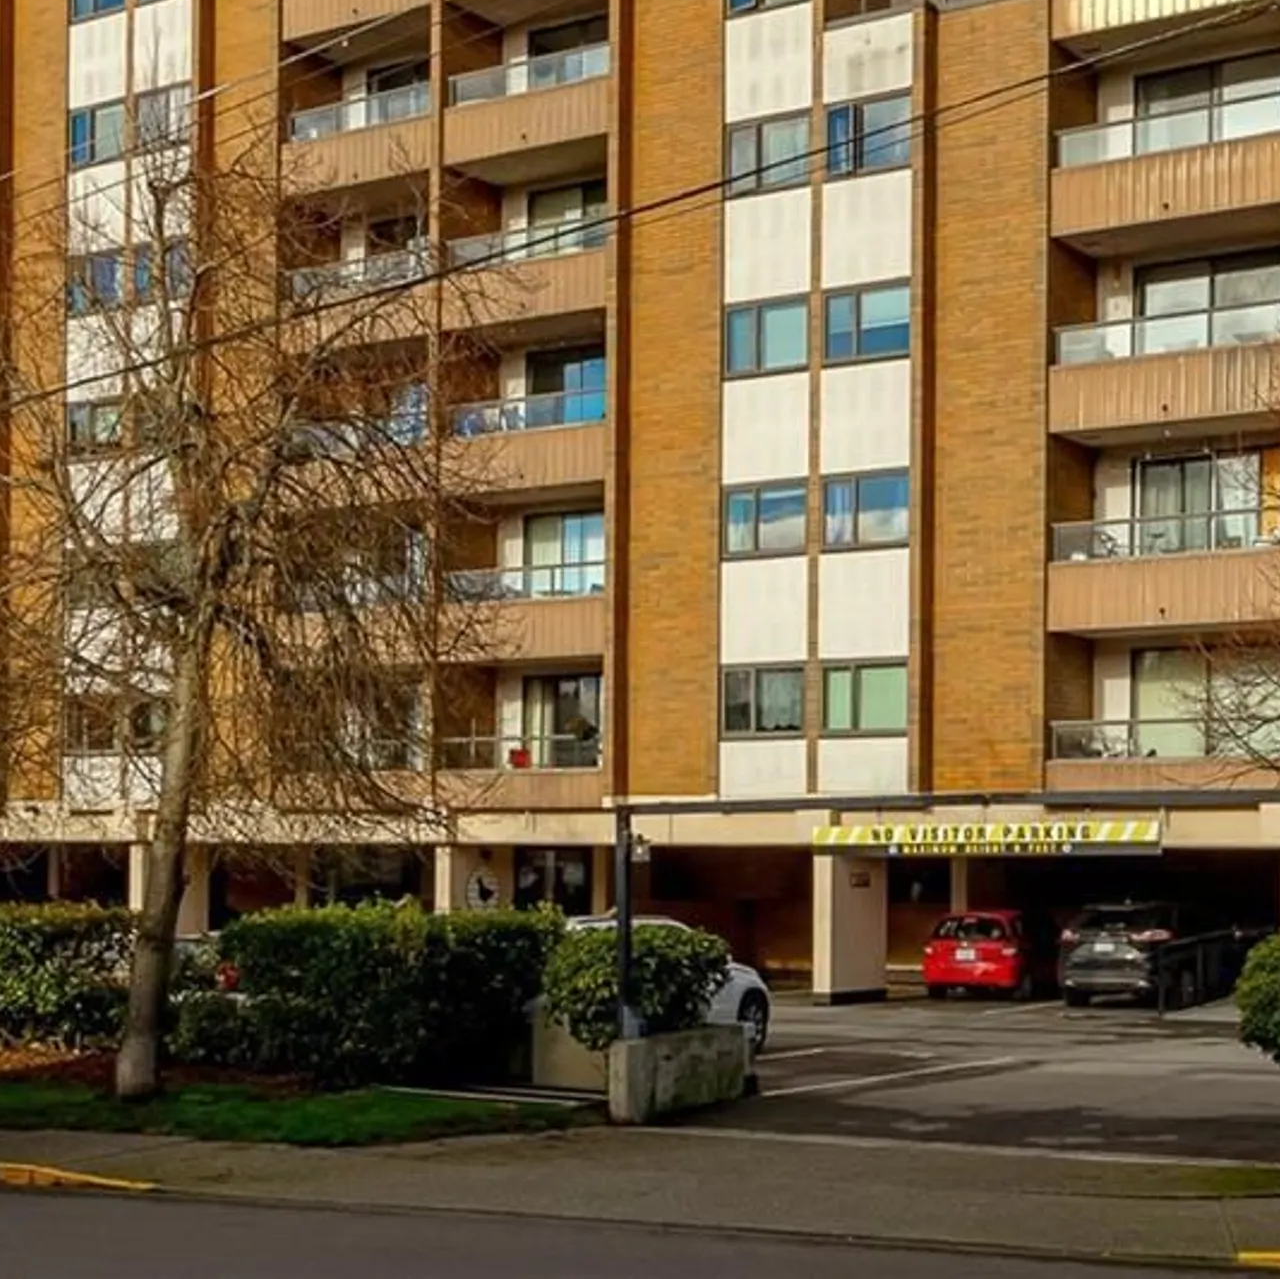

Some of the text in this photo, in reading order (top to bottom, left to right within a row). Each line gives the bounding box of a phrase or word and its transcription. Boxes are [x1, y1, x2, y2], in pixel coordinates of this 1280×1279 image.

[872, 824, 1091, 841] NO VISITOR PARKING
